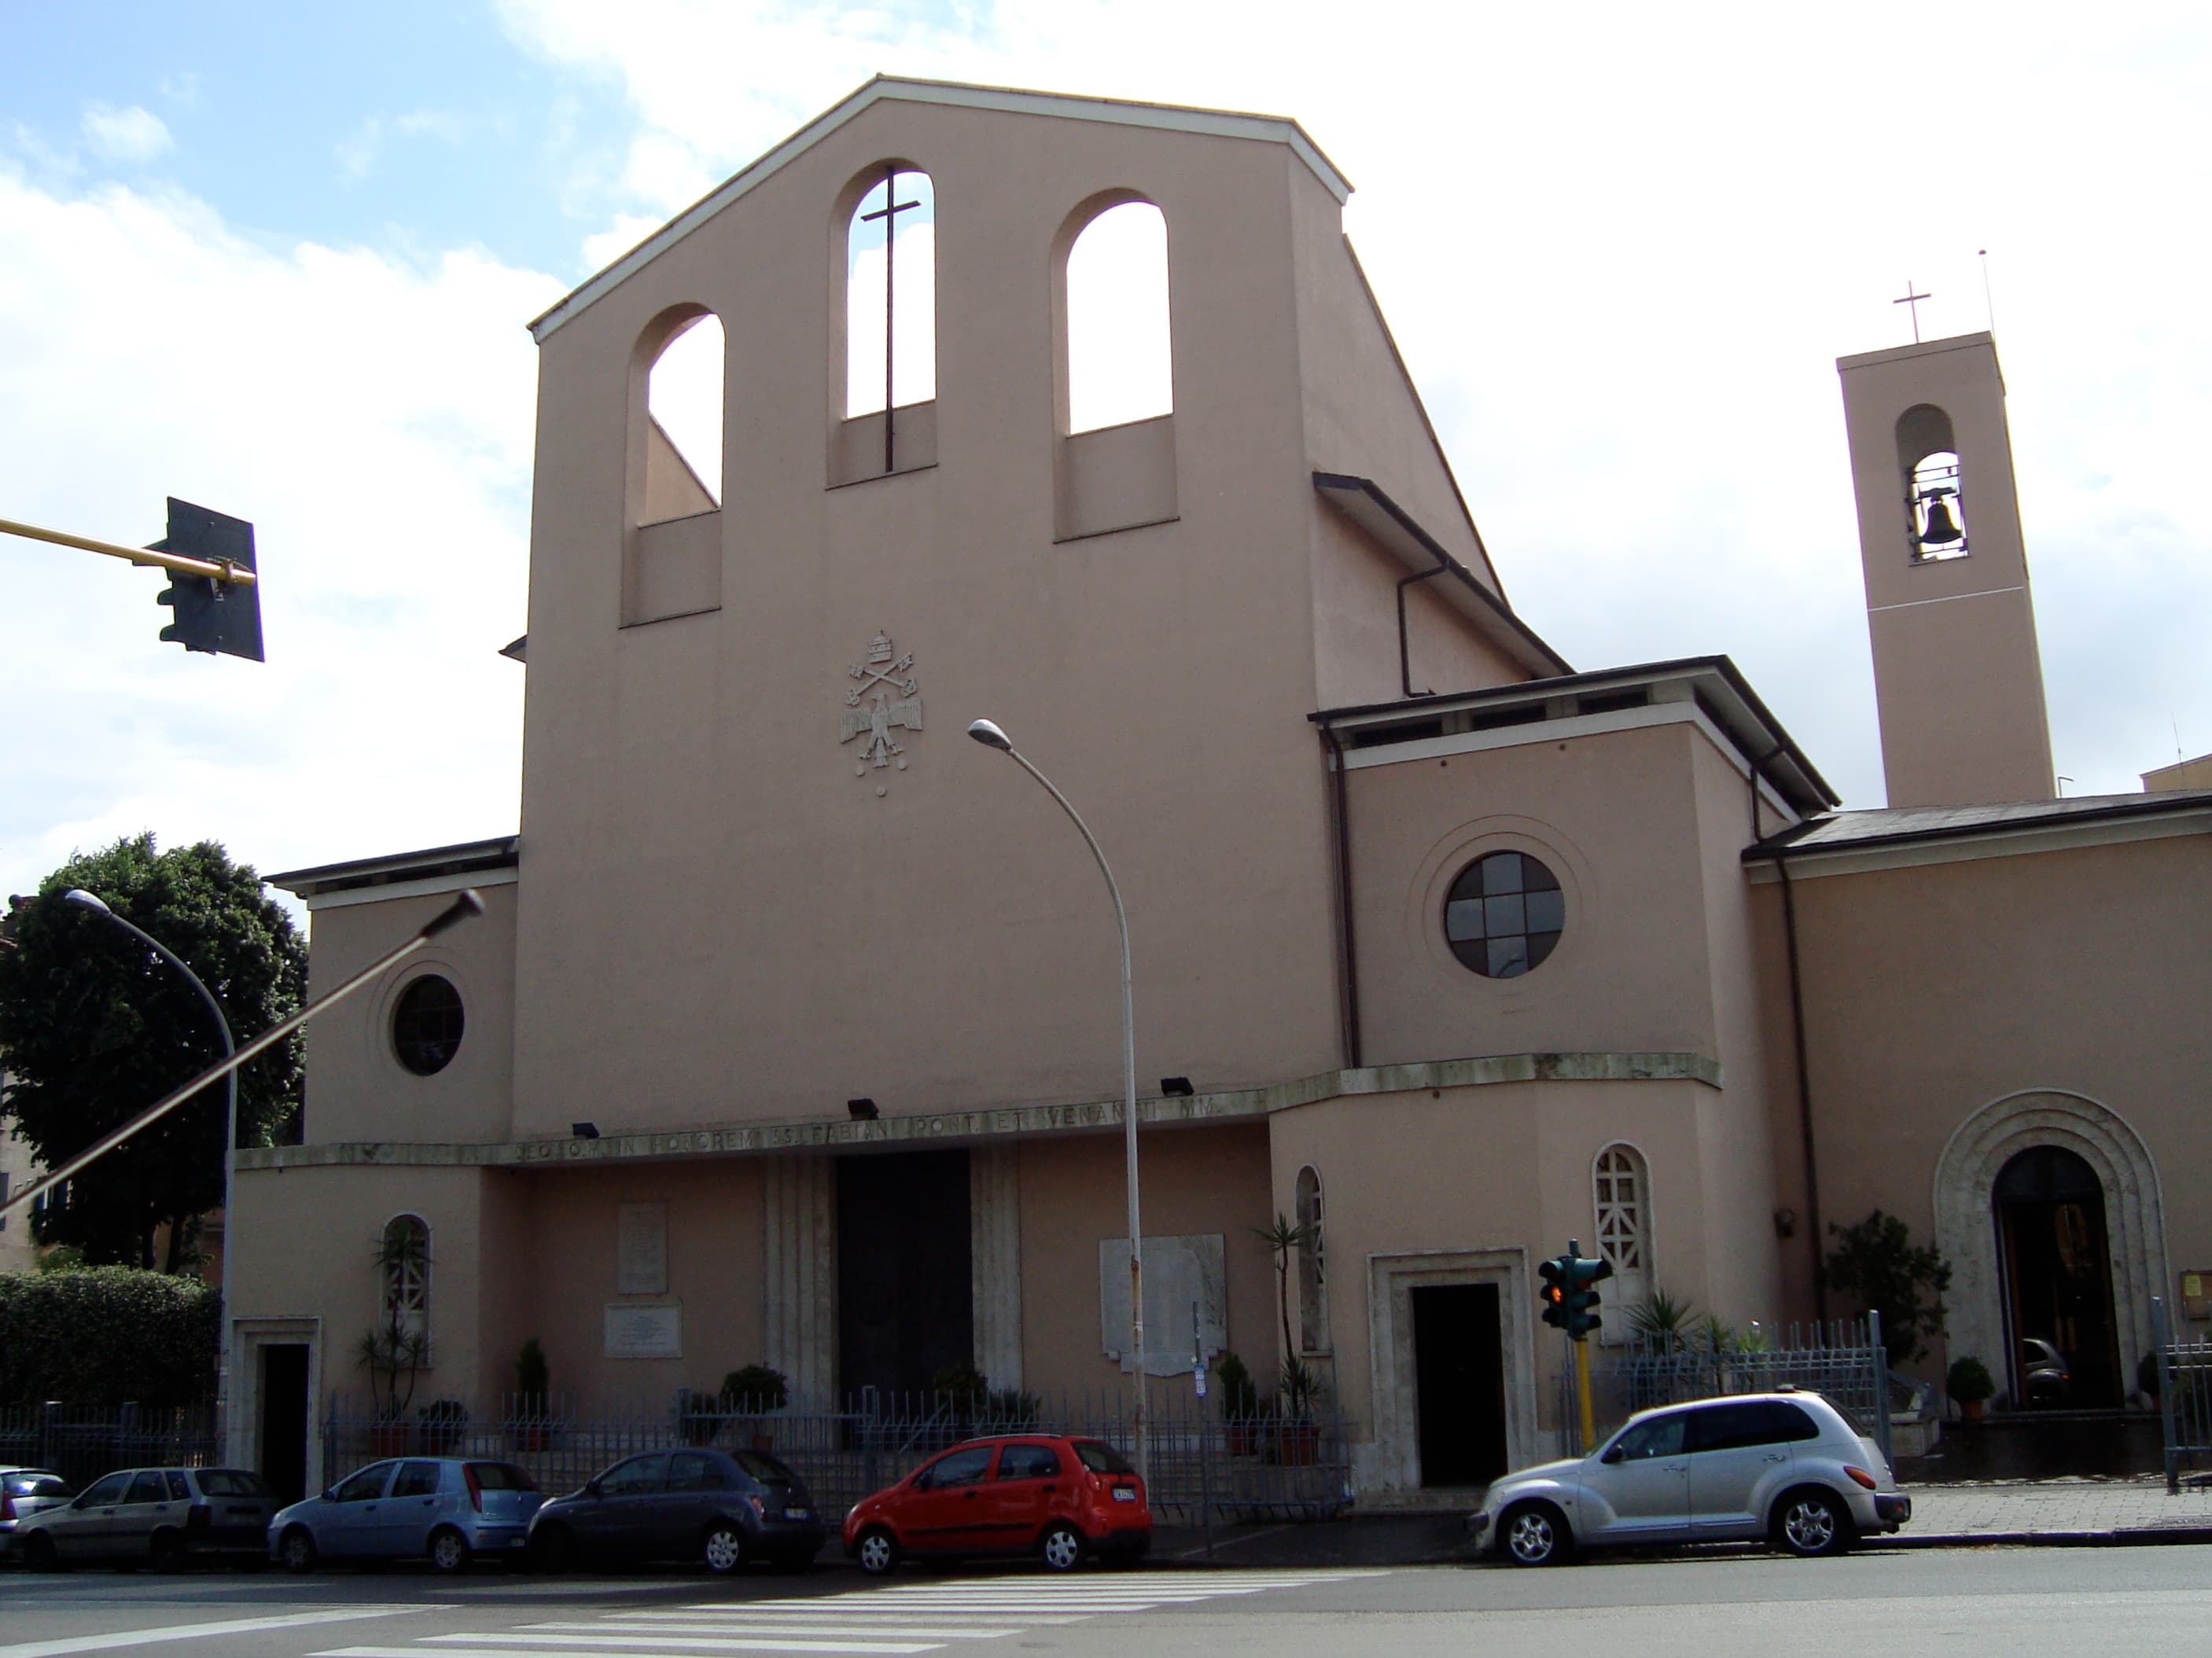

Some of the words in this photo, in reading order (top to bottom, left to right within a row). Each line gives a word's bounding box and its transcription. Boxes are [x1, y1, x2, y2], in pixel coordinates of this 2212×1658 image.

[651, 1128, 756, 1153] HONOREM
[996, 1110, 1021, 1129] ET
[1045, 1100, 1157, 1128] VENANII
